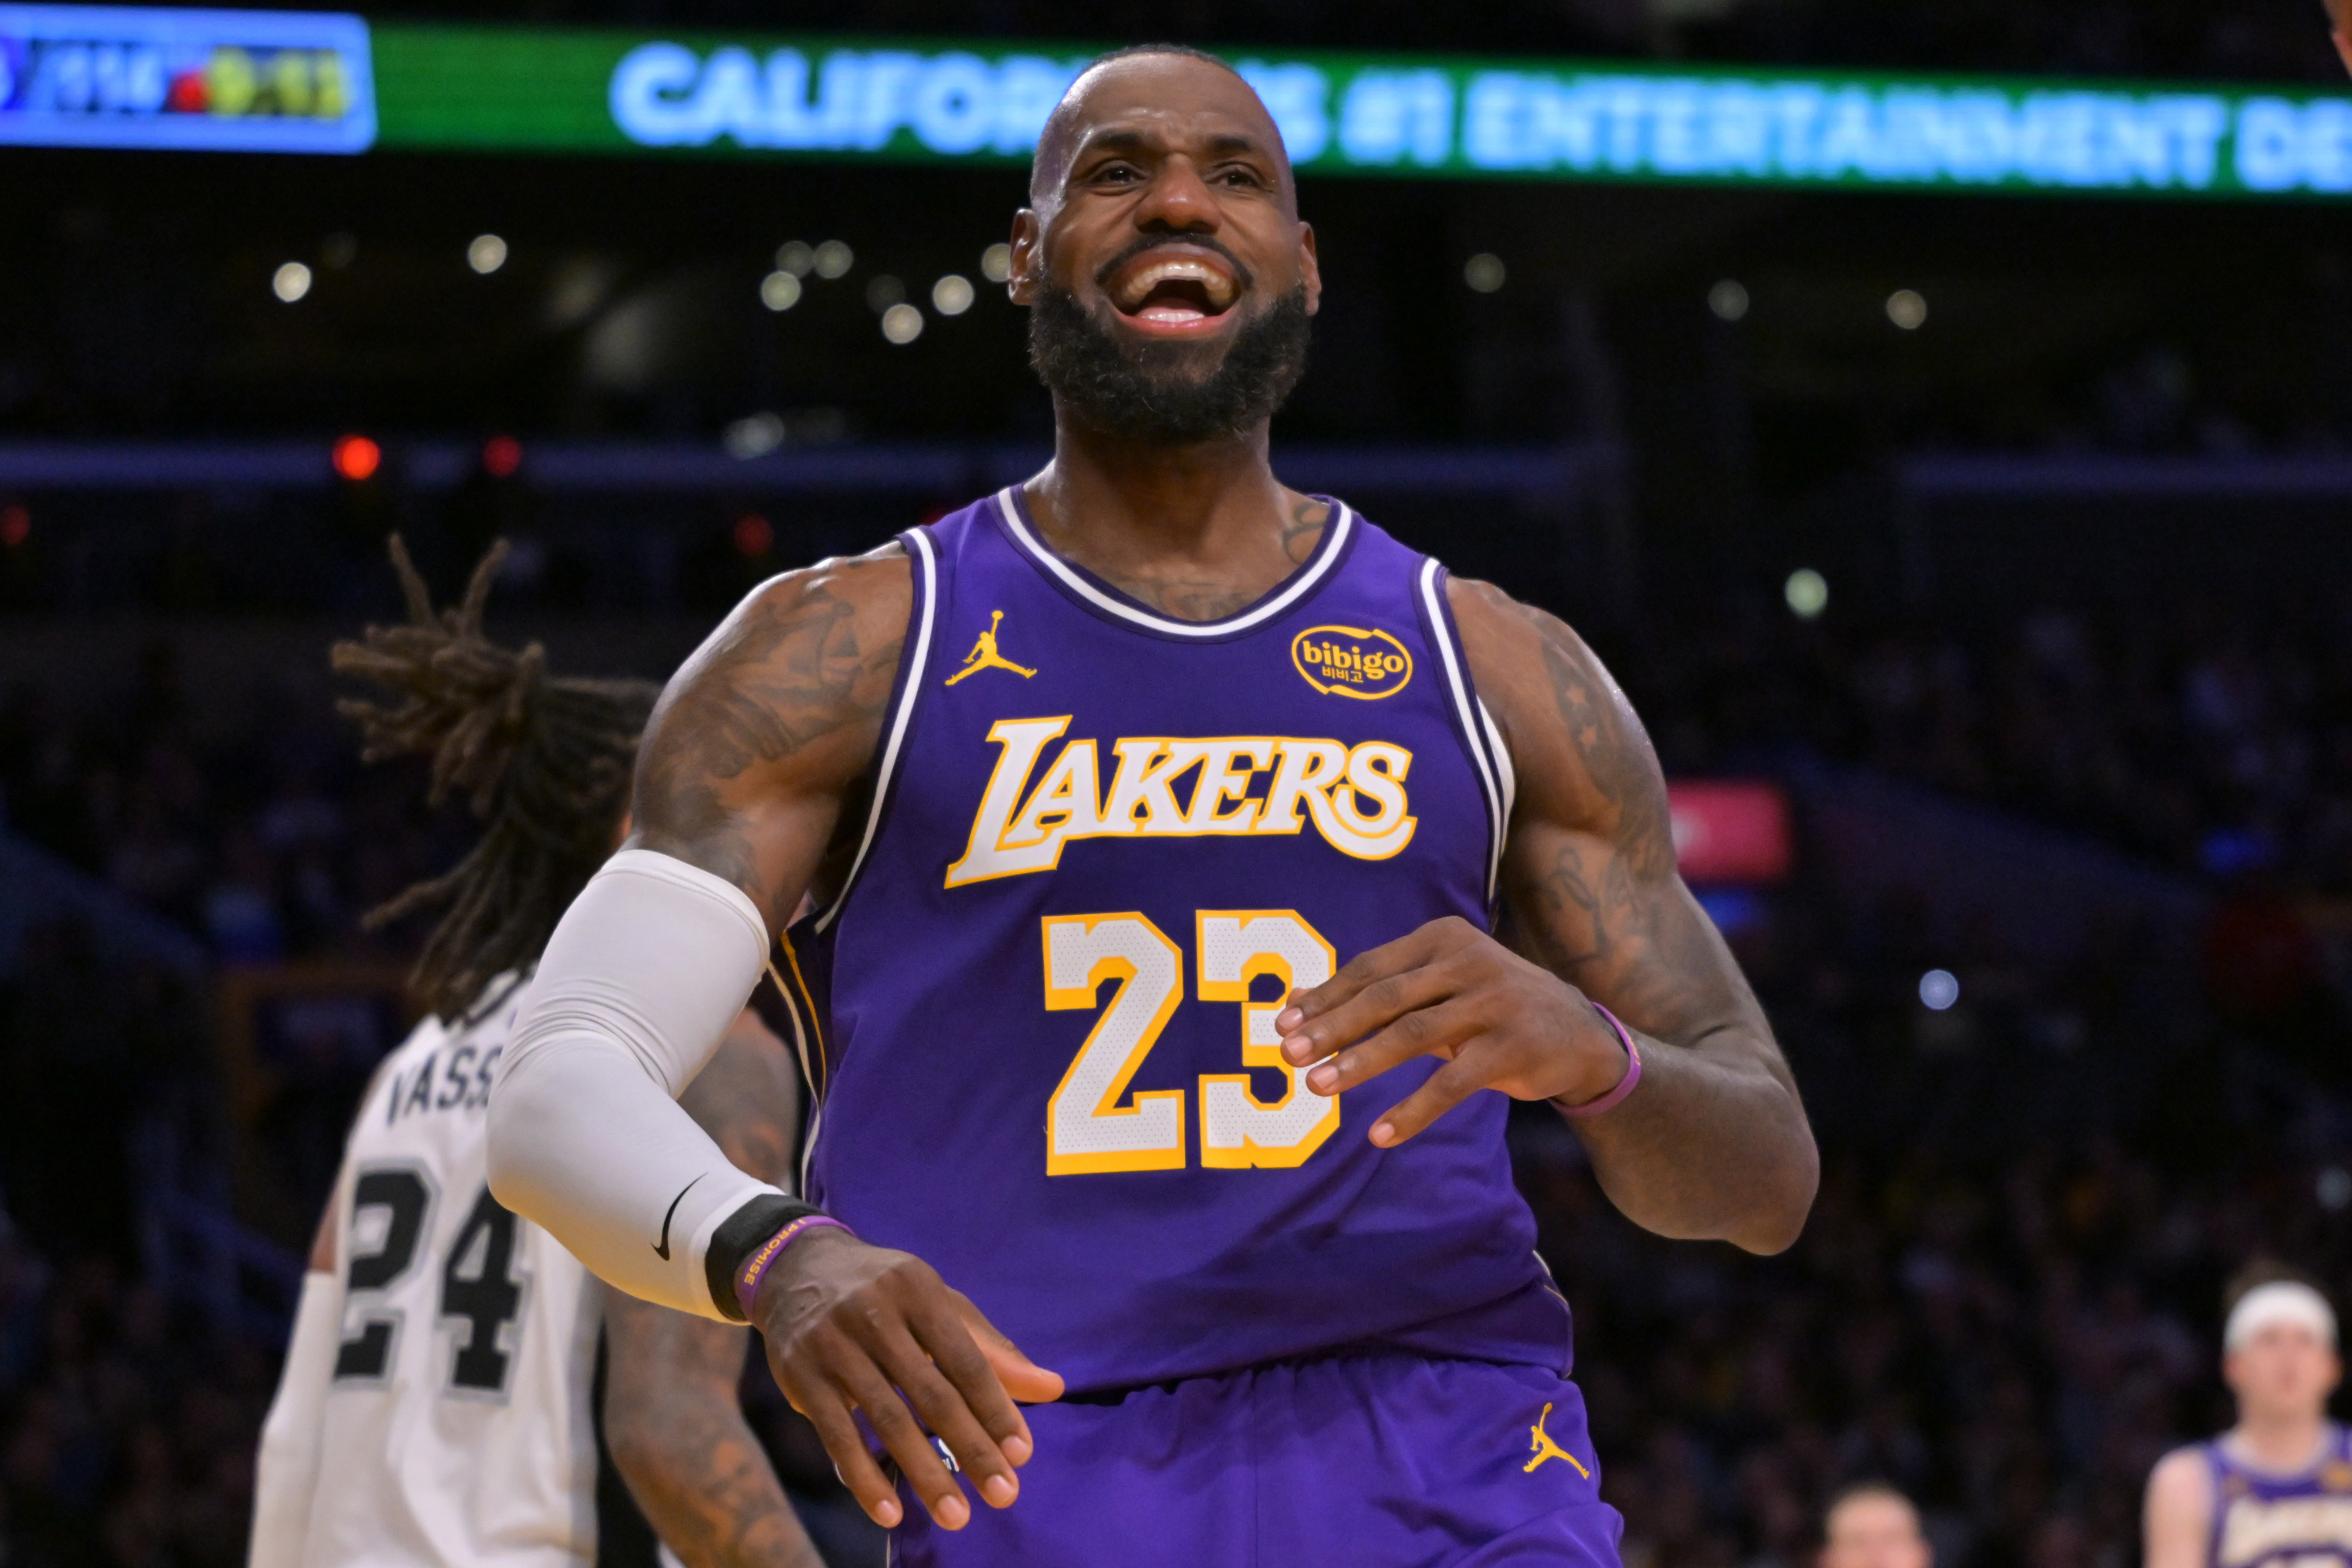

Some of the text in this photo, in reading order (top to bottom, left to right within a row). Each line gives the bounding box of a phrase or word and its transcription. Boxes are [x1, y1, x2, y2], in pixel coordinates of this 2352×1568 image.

[1465, 70, 2225, 189] ENTERTAINMENT
[1303, 640, 1404, 679] bibigo
[1322, 666, 1364, 683] 비비고
[944, 714, 1417, 889] LAKERS
[1041, 910, 1340, 1176] 23
[333, 1156, 530, 1403] 24
[744, 1223, 799, 1286] PROMISE
